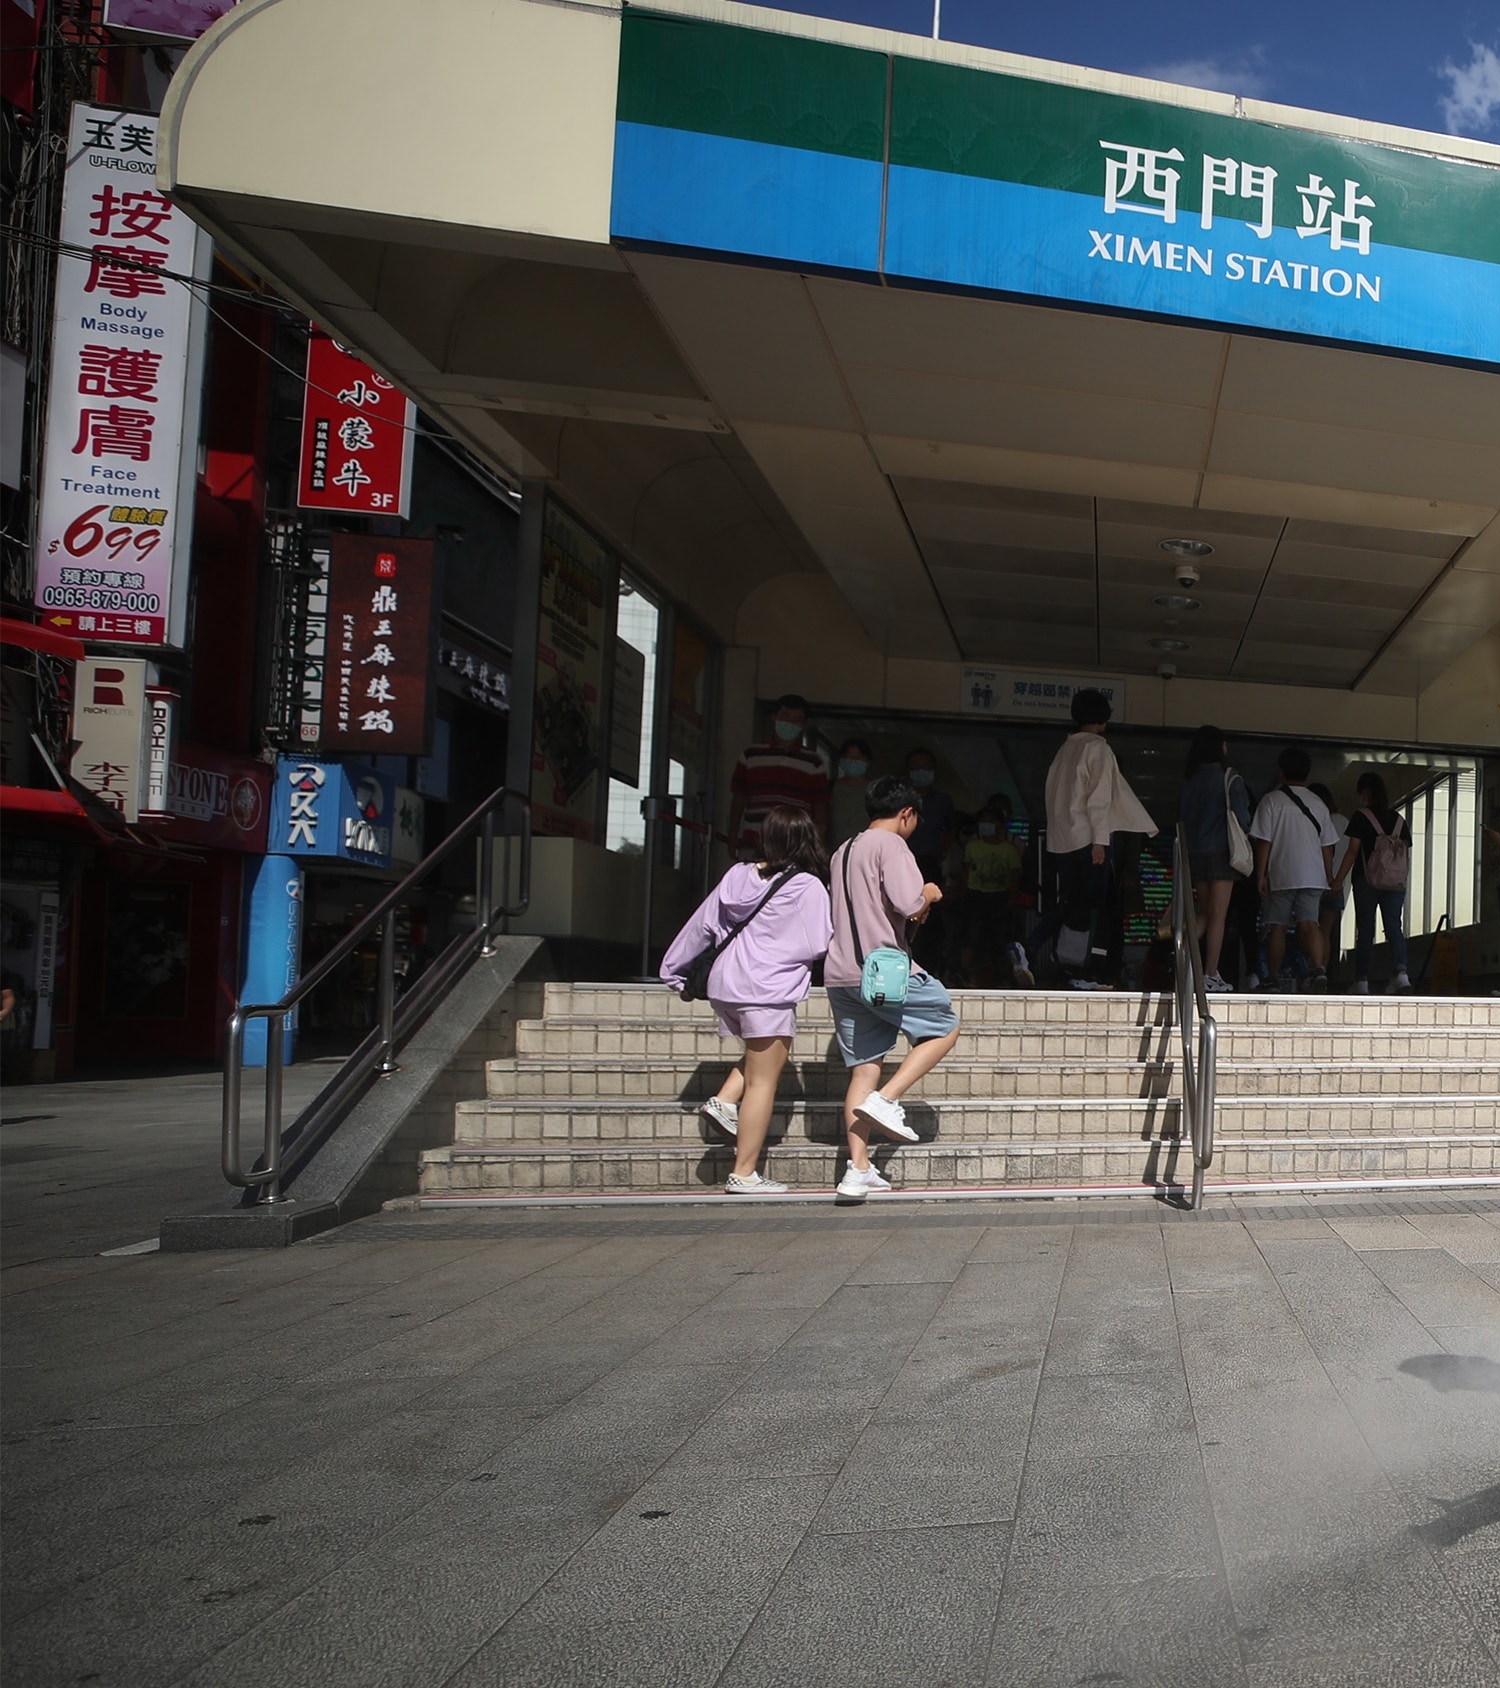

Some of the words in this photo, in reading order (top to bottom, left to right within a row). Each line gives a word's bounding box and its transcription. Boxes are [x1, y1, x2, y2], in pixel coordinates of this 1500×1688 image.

[83, 118, 158, 157] 玉芙
[89, 154, 157, 175] U-FLOW
[1099, 140, 1376, 255] 西門站
[84, 184, 172, 299] 按摩
[1088, 229, 1213, 276] XIMEN
[1225, 252, 1381, 302] STATION
[100, 302, 147, 322] Body
[81, 317, 165, 339] Massage
[71, 344, 163, 462] 護膚
[332, 380, 380, 497] 小蒙牛
[91, 465, 137, 481] Face
[60, 478, 160, 499] Treatment
[370, 492, 394, 507] 3F
[47, 504, 162, 562] $699
[60, 567, 145, 589] 預約專線
[43, 586, 159, 613] 0965-879-000
[78, 615, 152, 636] 請上三樓
[358, 585, 398, 734] 鼎王麻辣鍋
